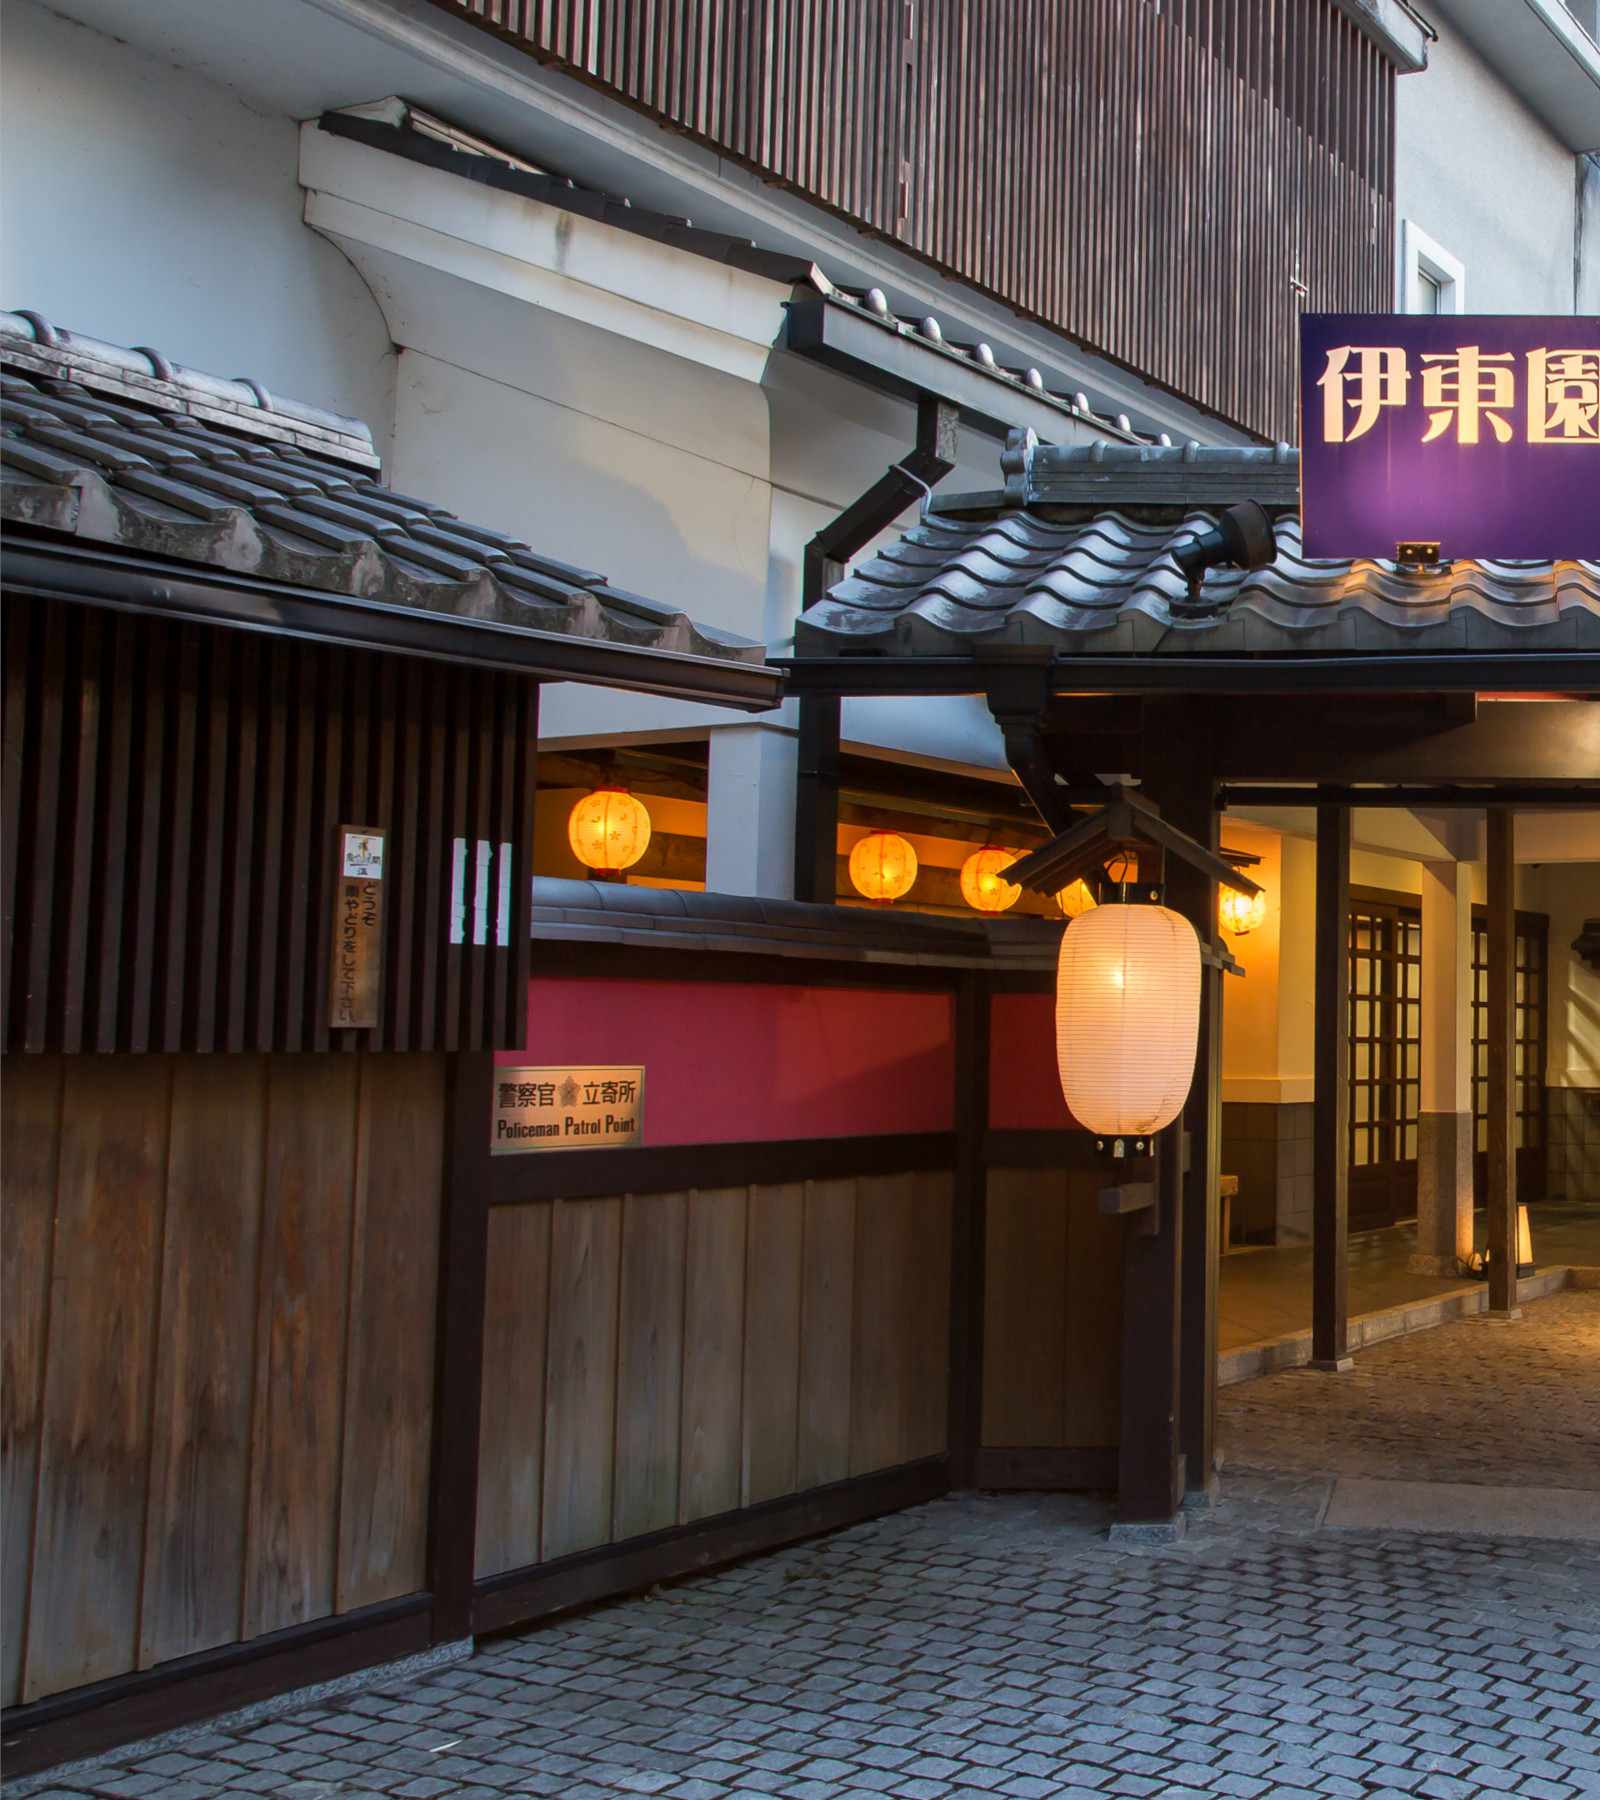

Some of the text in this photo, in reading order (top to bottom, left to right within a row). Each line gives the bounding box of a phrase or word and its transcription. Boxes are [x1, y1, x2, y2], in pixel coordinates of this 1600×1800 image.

[498, 1080, 636, 1108] 警察官 立寄所
[498, 1114, 635, 1139] Policeman Patrol Point
